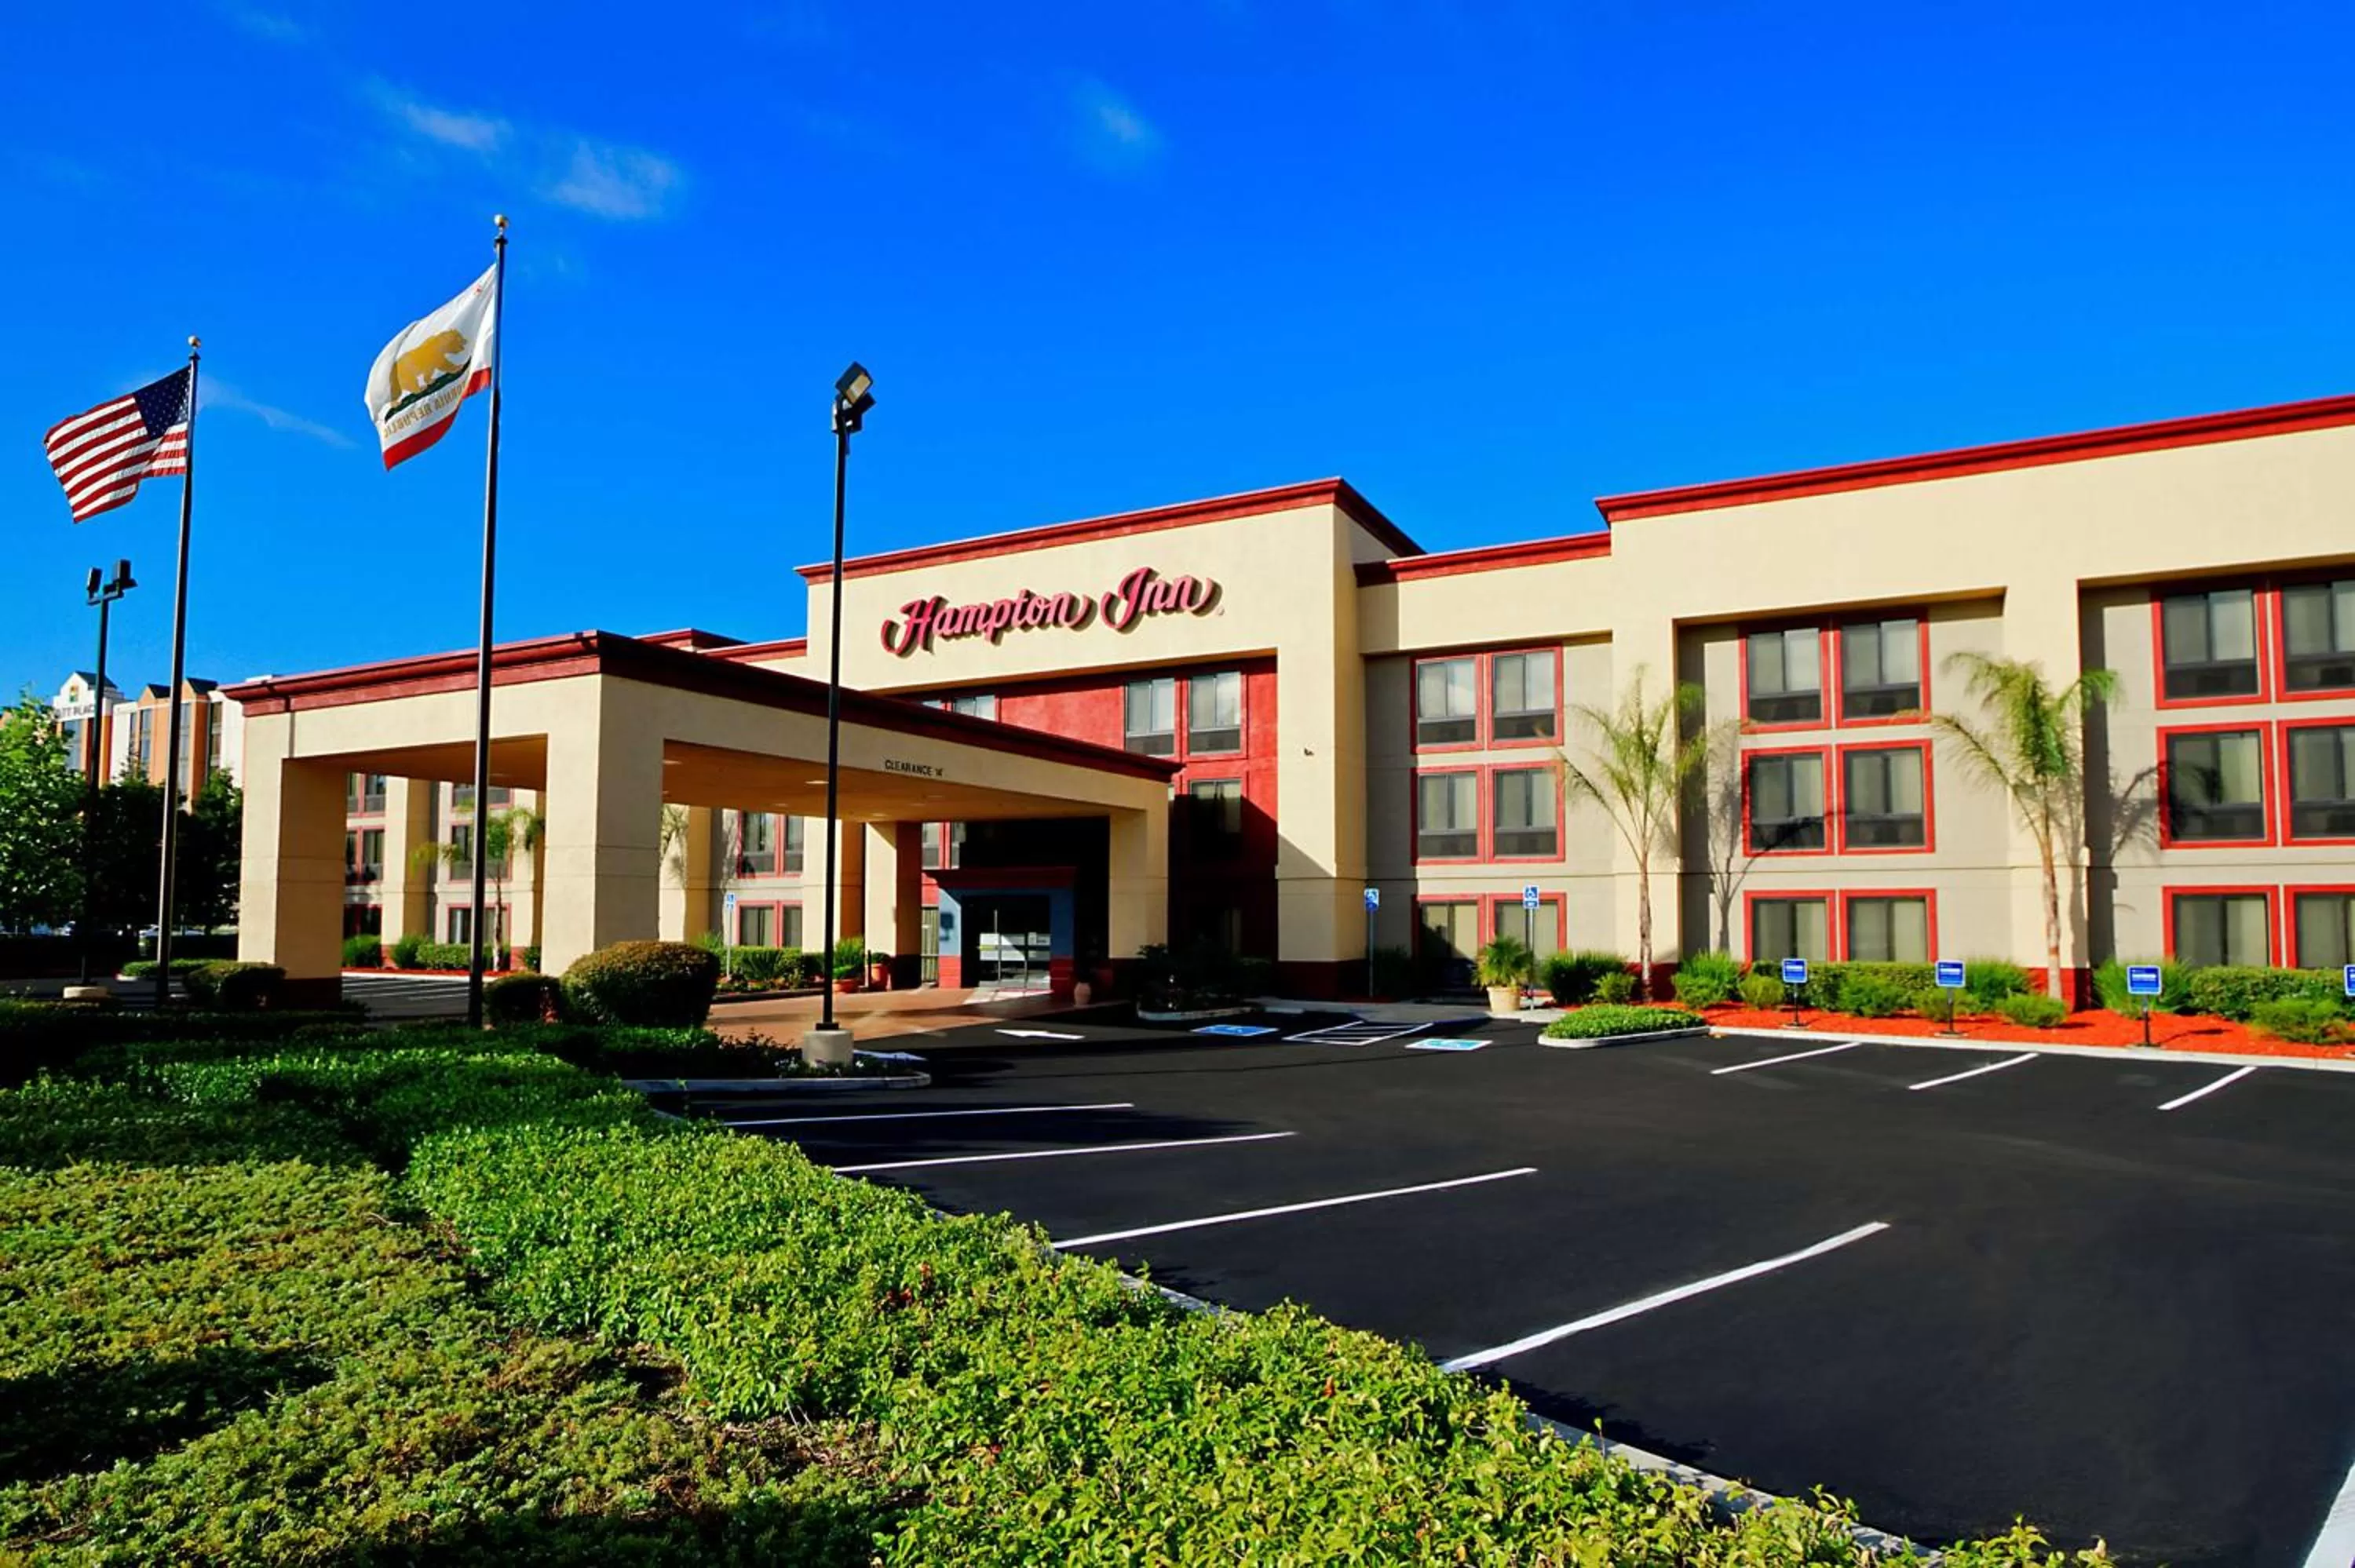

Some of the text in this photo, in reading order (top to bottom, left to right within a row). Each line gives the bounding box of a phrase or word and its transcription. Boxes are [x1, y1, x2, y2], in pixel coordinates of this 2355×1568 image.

[881, 567, 1217, 656] Hampton Inn
[885, 759, 932, 776] CLEARANCE
